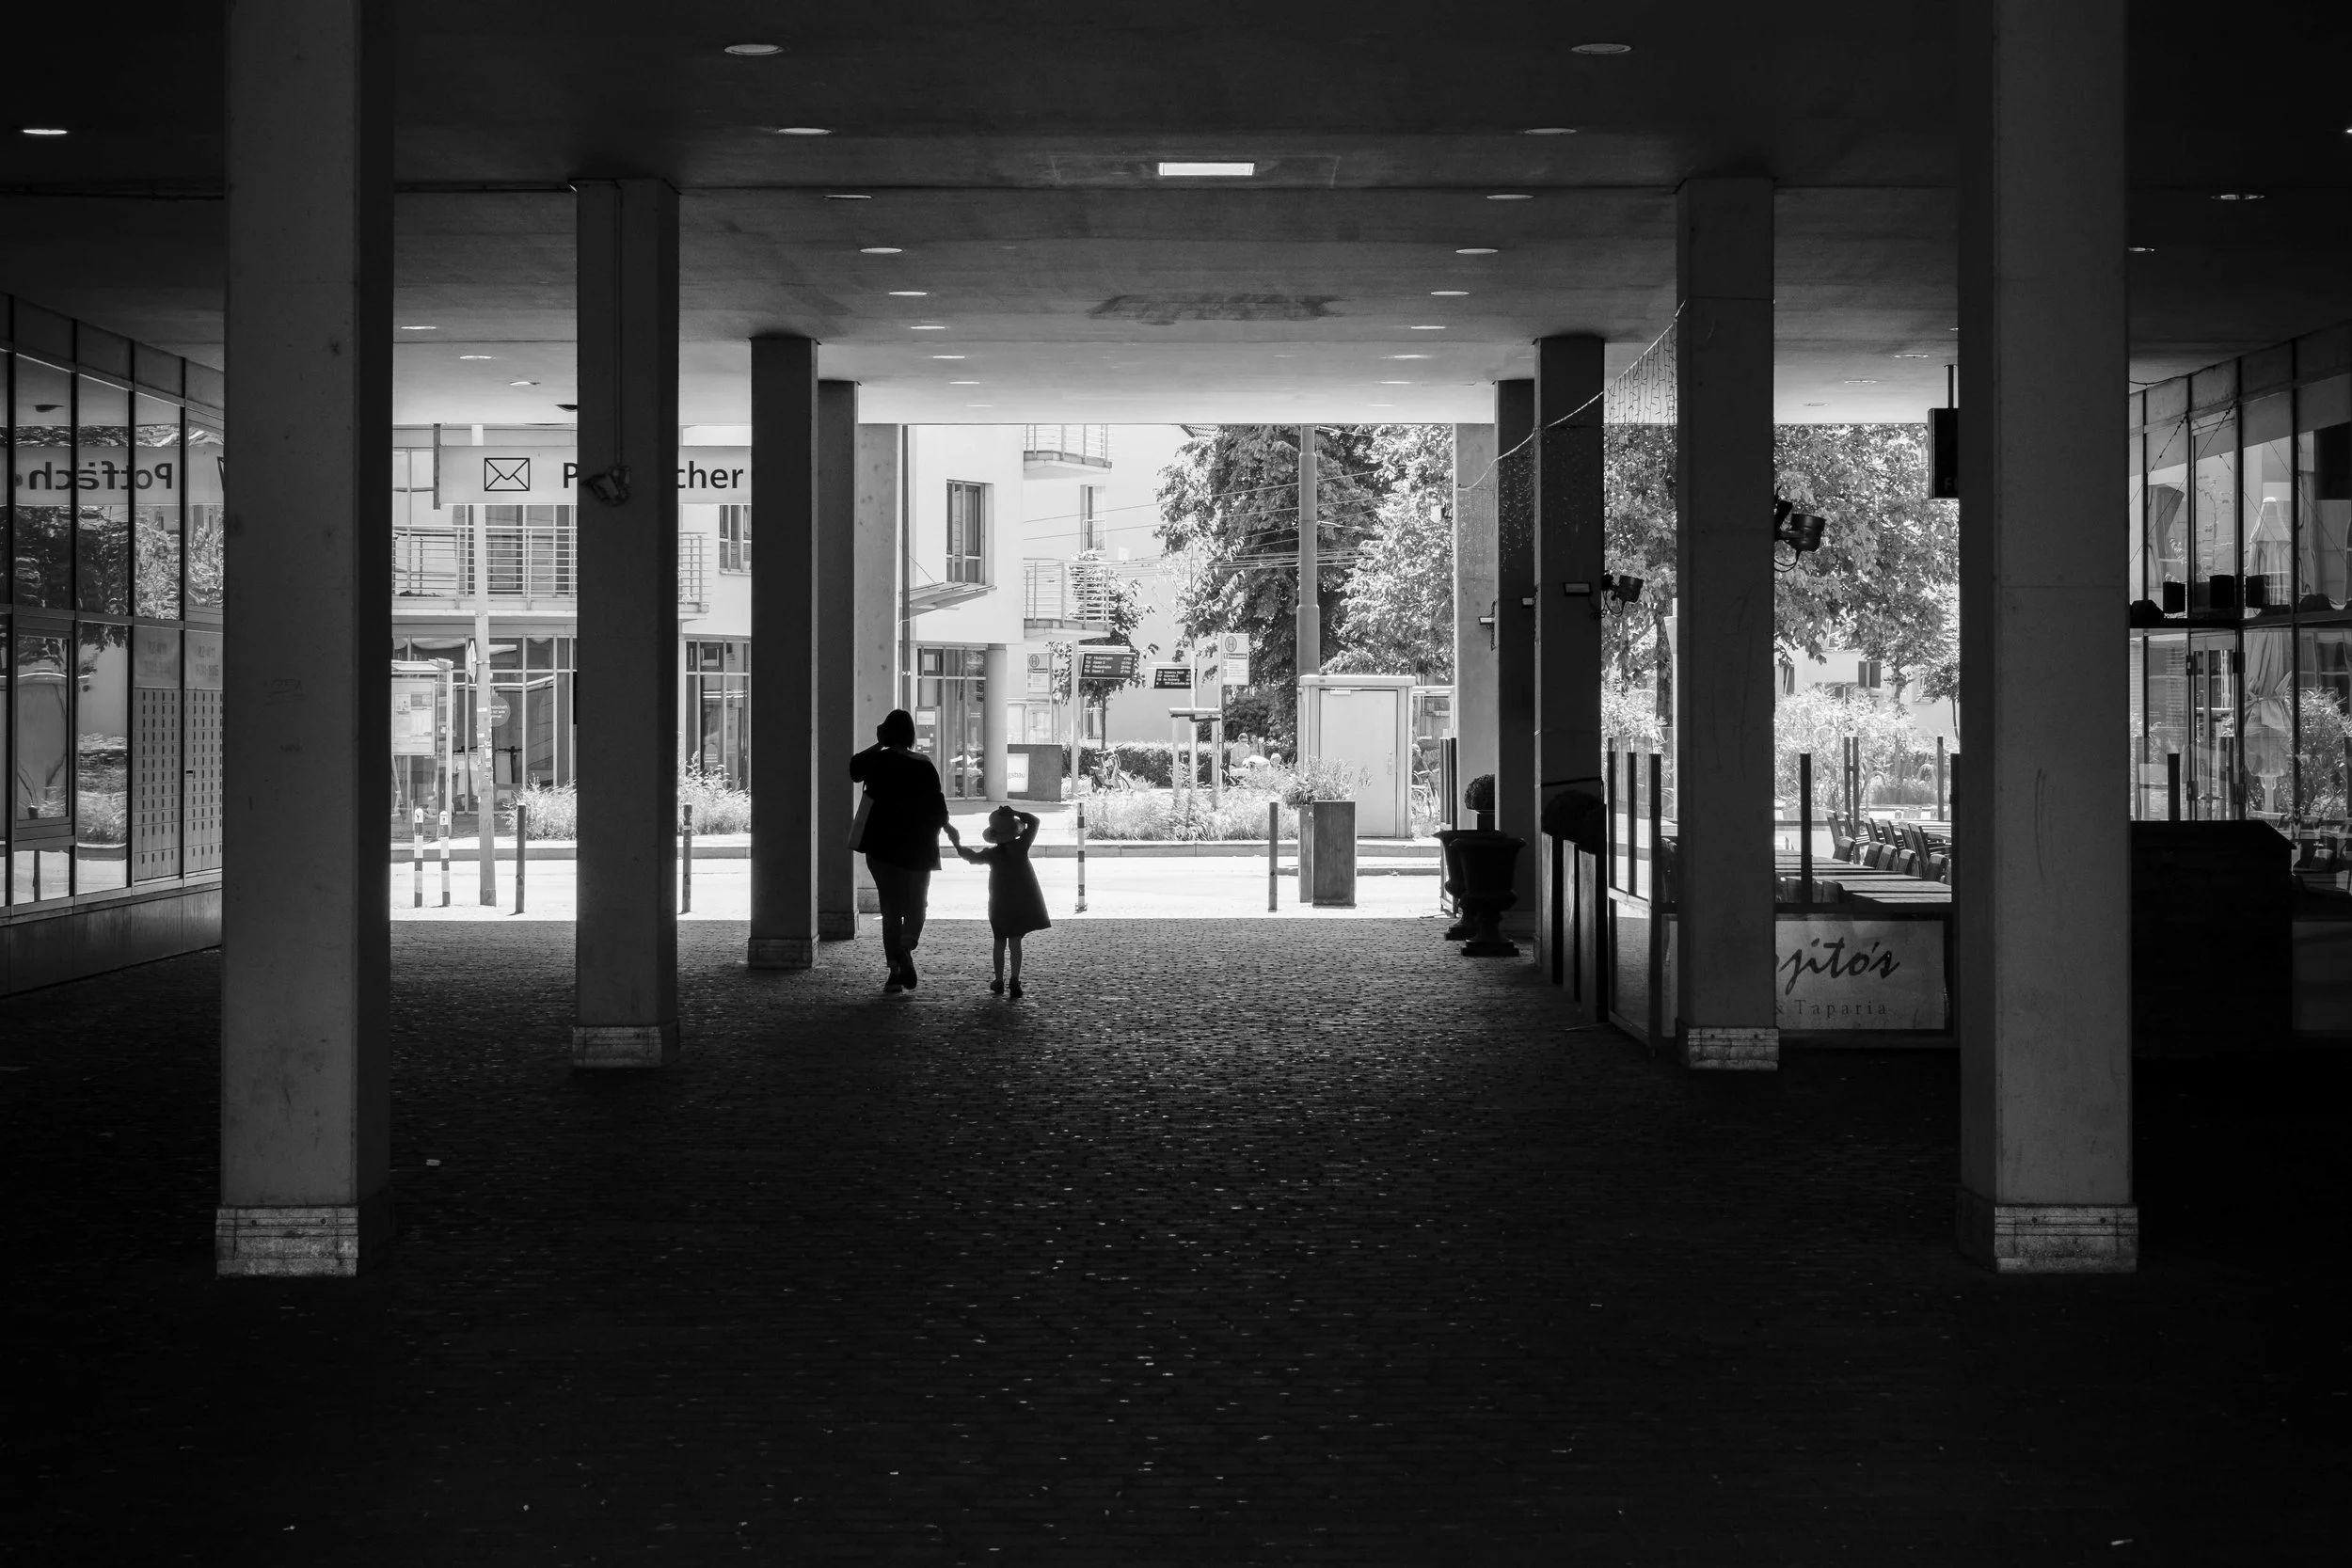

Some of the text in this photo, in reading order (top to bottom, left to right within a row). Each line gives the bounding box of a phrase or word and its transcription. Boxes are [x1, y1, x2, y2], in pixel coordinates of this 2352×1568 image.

[563, 460, 744, 489] Pcher
[1776, 937, 1900, 996] jito's
[1794, 999, 1887, 1019] Taparia
